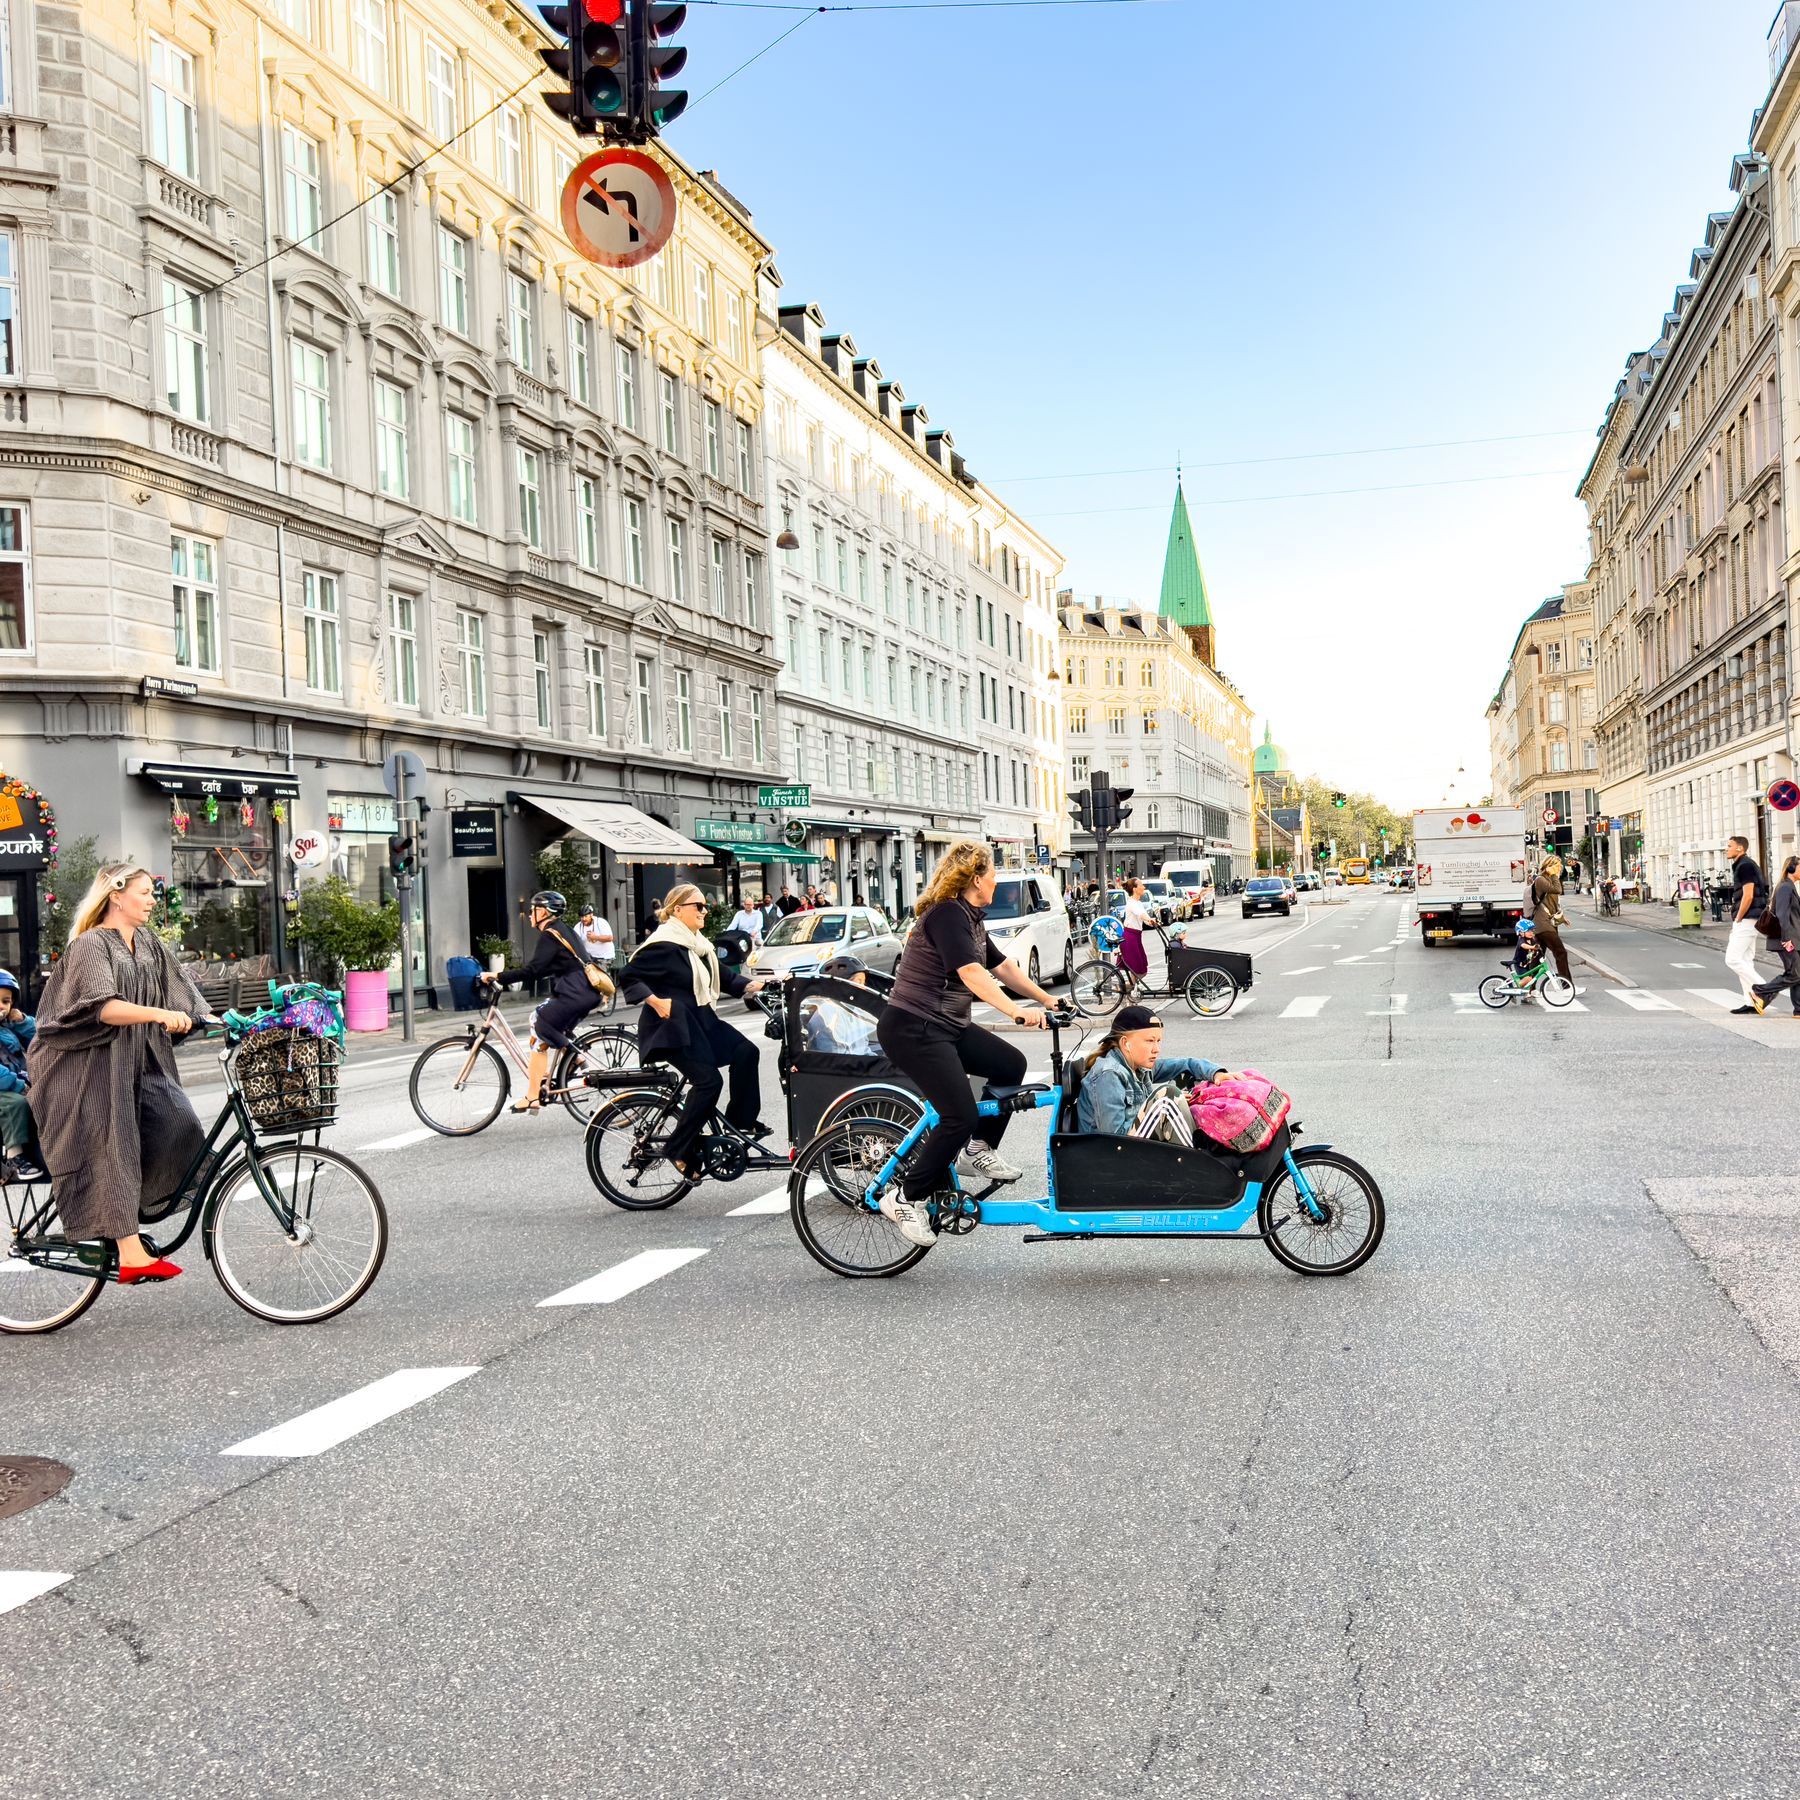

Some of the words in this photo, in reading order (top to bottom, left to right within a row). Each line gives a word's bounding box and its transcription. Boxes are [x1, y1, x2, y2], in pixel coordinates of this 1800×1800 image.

[241, 782, 258, 795] bar
[760, 795, 808, 806] VINSTUE
[375, 806, 387, 821] 87
[1038, 846, 1047, 857] P
[1143, 1215, 1210, 1227] BULLITT
